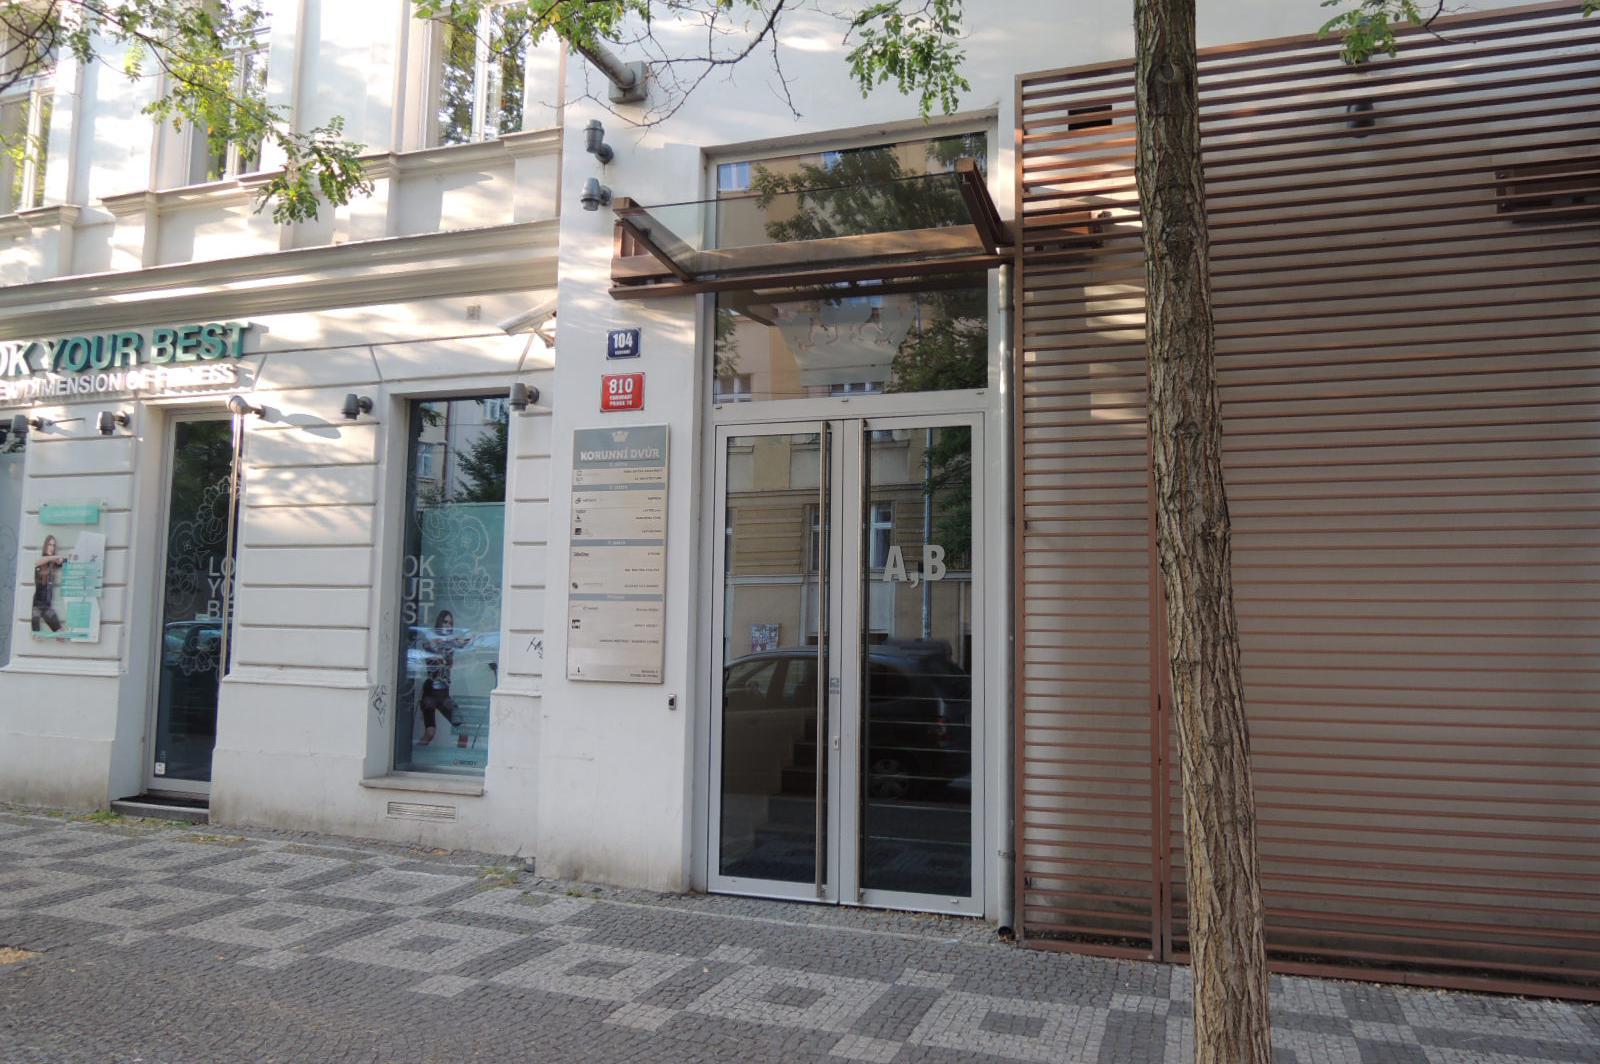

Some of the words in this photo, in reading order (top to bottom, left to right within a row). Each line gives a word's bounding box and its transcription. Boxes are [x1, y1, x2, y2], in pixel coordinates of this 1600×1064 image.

[42, 331, 143, 373] YOUR
[151, 322, 251, 365] BEST
[613, 333, 633, 349] 104
[23, 372, 122, 397] DIMENSION
[609, 378, 633, 394] 810
[883, 544, 946, 589] A,B
